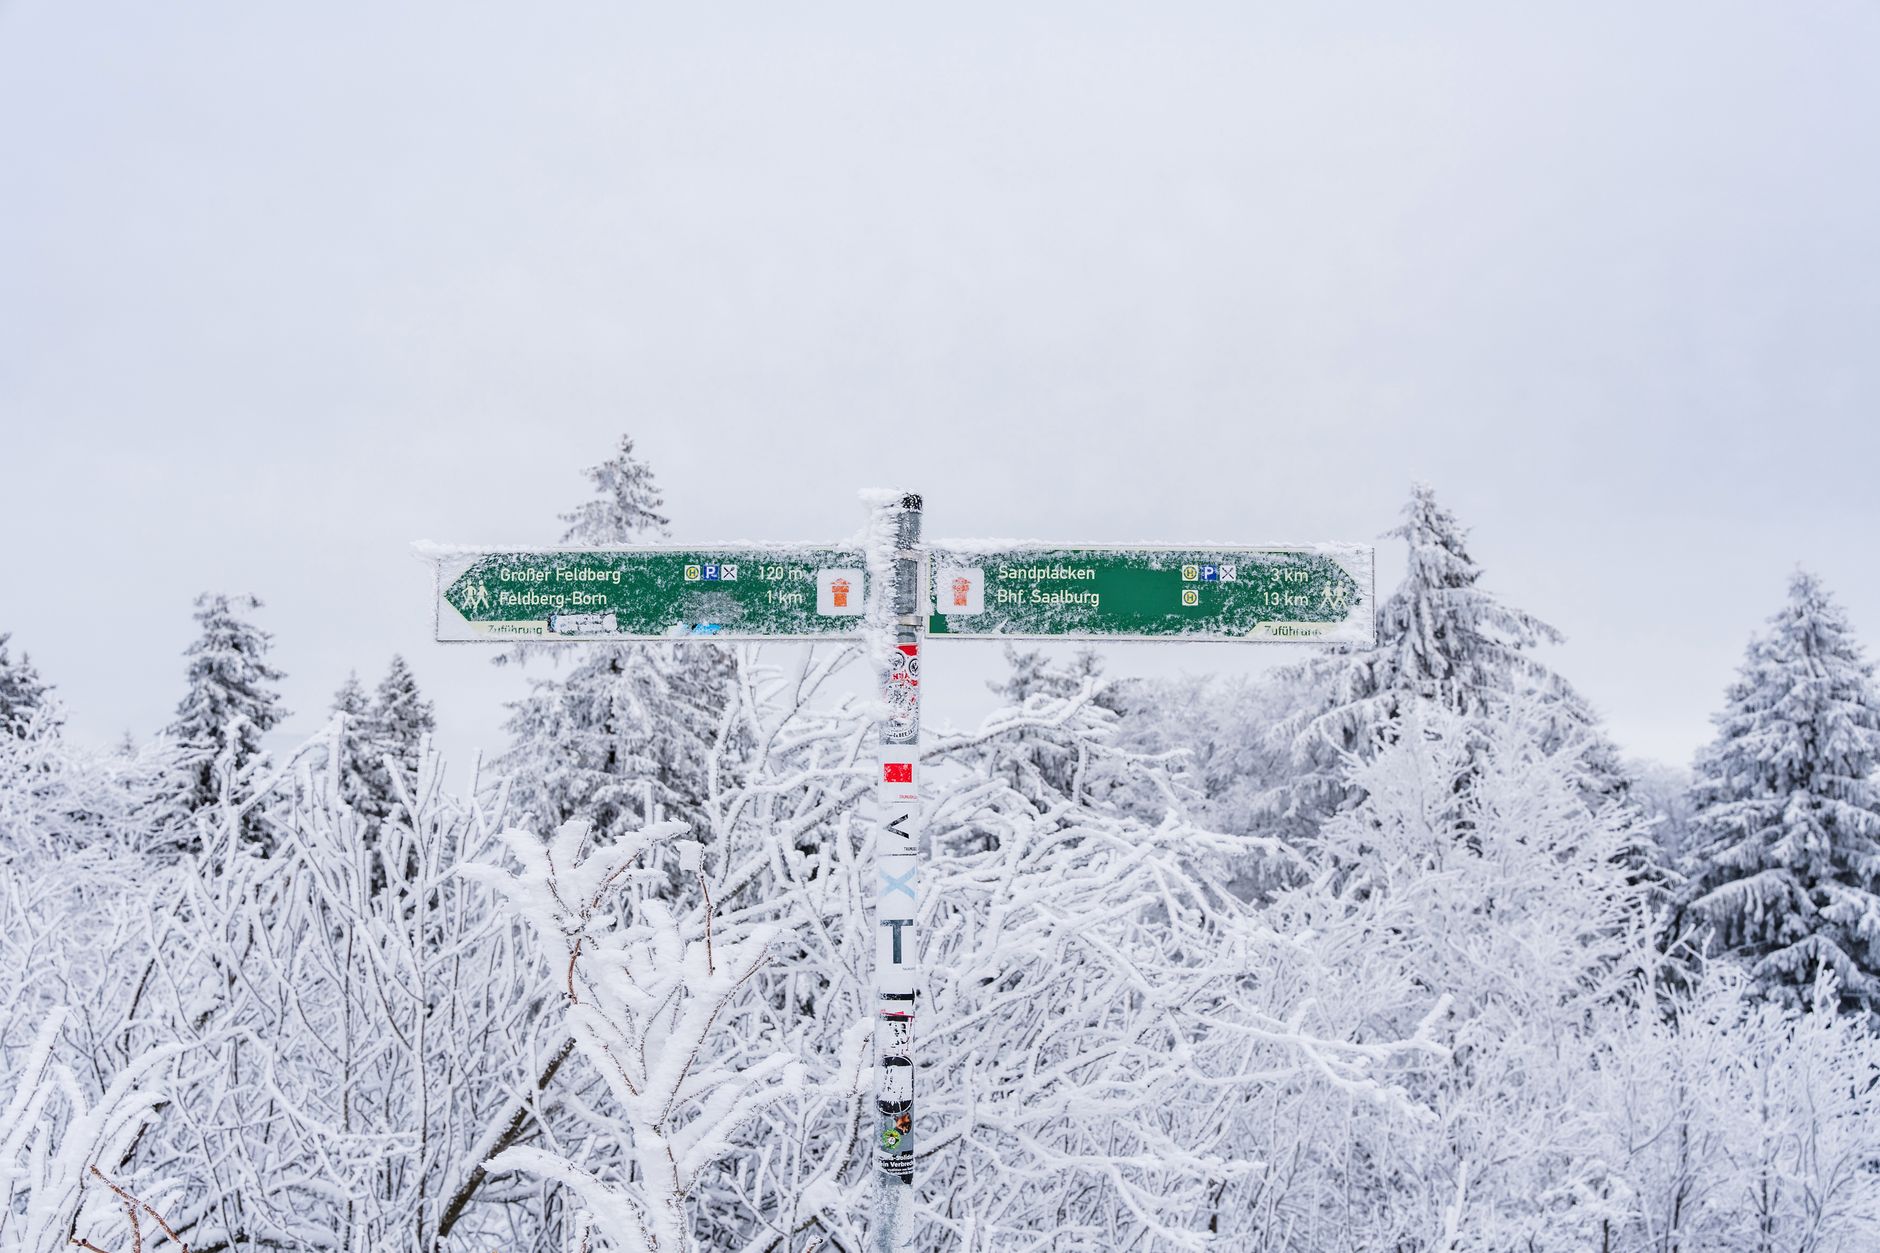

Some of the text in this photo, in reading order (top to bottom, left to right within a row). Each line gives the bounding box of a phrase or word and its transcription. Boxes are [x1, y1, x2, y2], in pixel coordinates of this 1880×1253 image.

[500, 567, 621, 584] Großer Feldberg
[758, 566, 804, 581] 120 m
[997, 565, 1096, 582] Sandplacken
[1270, 567, 1309, 582] 3 km
[499, 591, 607, 608] Feldberg-Born
[765, 590, 804, 604] 1 km
[997, 589, 1100, 607] Bhf. Saalburg
[1263, 592, 1309, 606] 13 km
